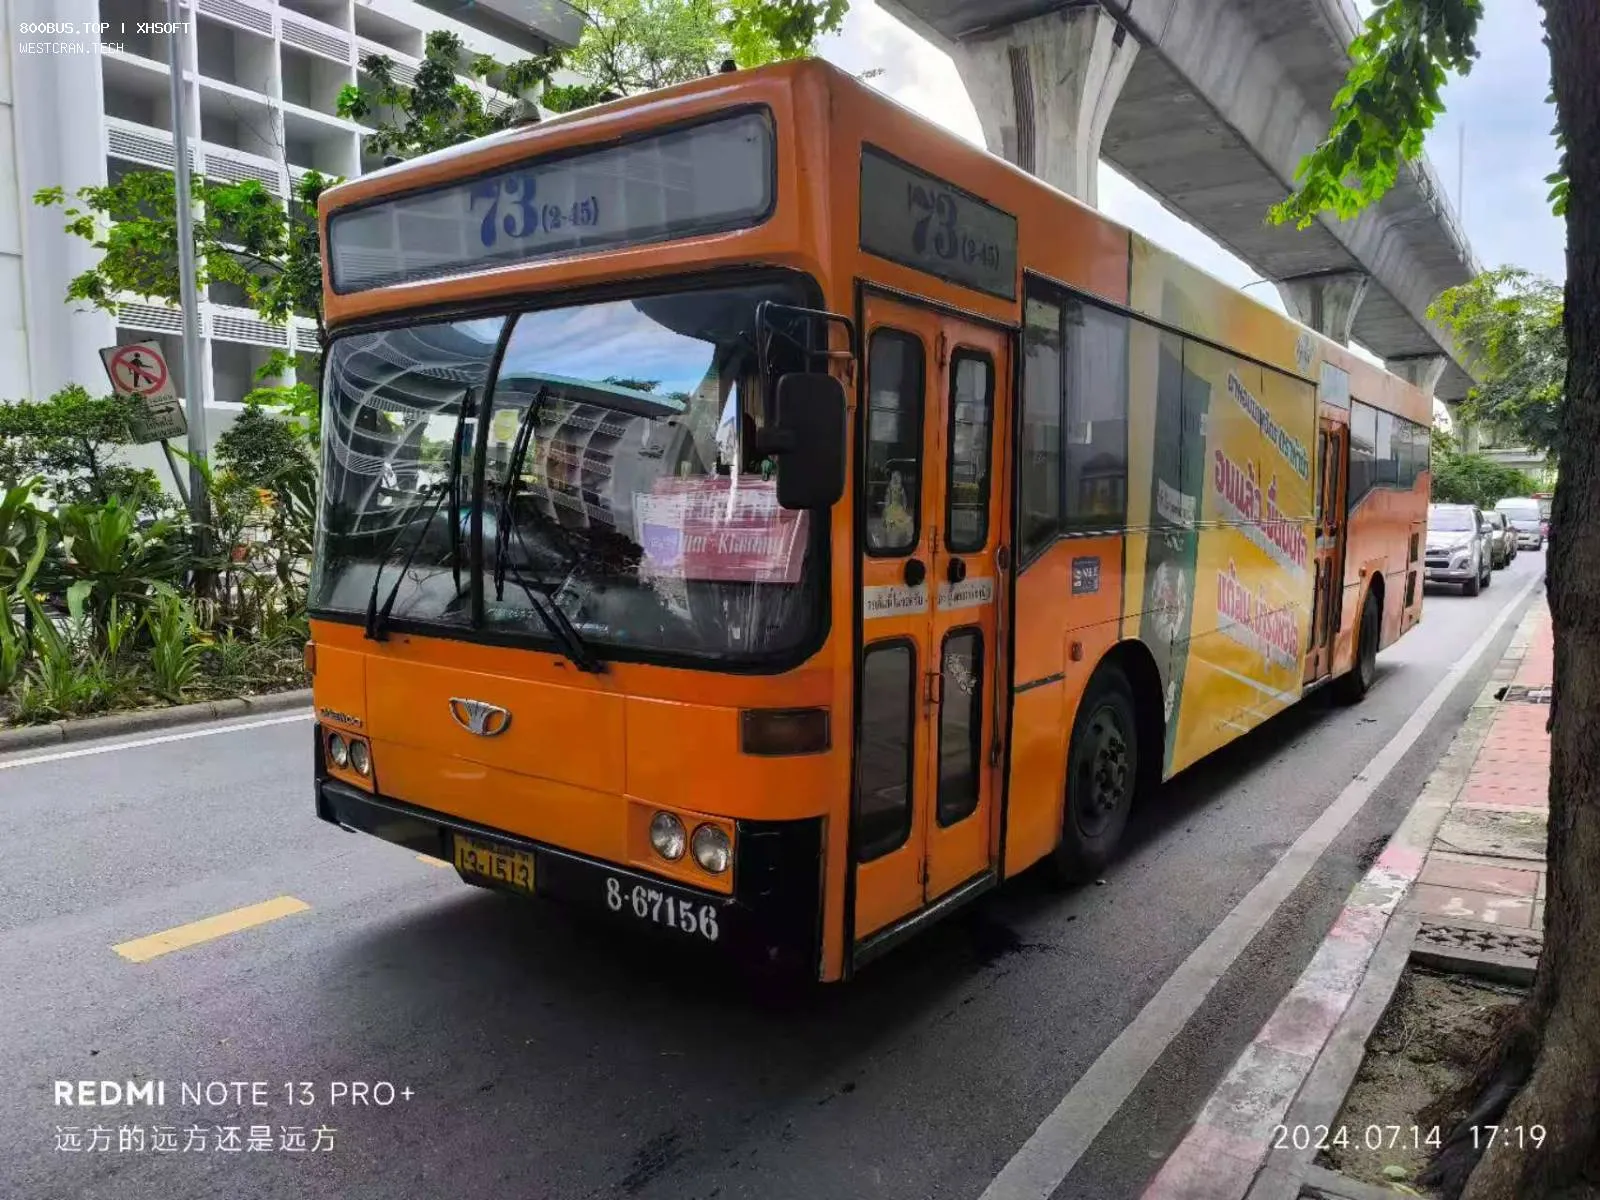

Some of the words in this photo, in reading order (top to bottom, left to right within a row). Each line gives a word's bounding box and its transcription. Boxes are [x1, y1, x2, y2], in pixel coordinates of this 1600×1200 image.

[470, 173, 538, 248] 73
[541, 196, 599, 233] (2-45)
[908, 181, 958, 260] 73
[605, 876, 719, 941] 8-67156
